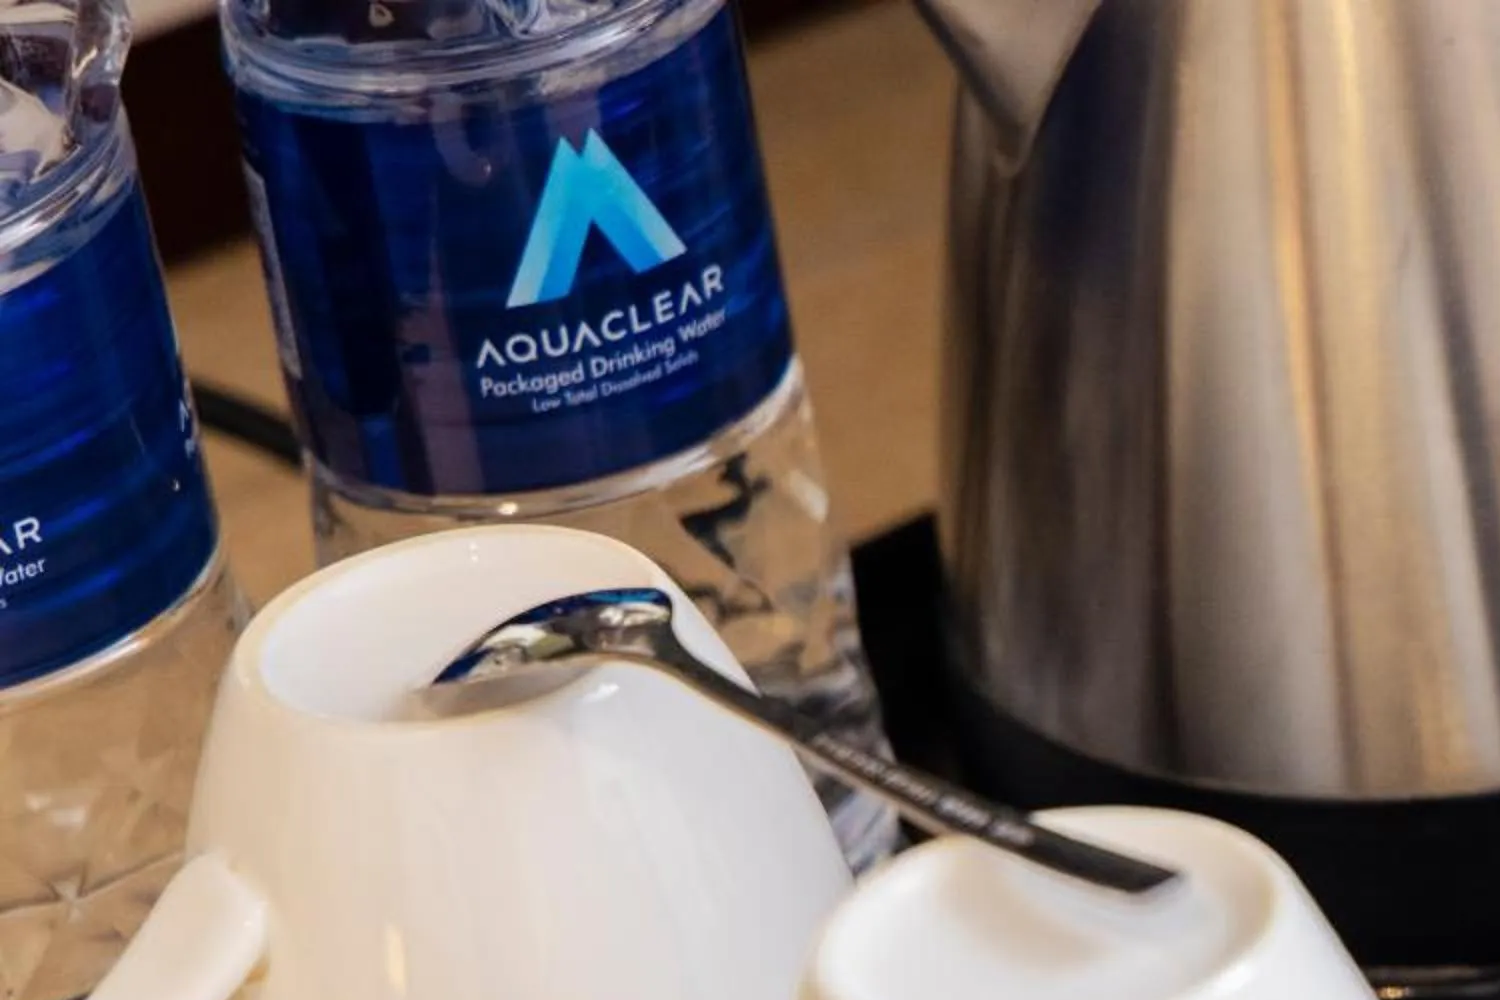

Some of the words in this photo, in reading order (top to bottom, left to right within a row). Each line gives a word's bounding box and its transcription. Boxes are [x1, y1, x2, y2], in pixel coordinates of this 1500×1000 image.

[476, 264, 725, 369] AQUACLEAR
[480, 361, 585, 399] Packaged
[590, 336, 676, 379] Drinking
[677, 307, 727, 343] Water
